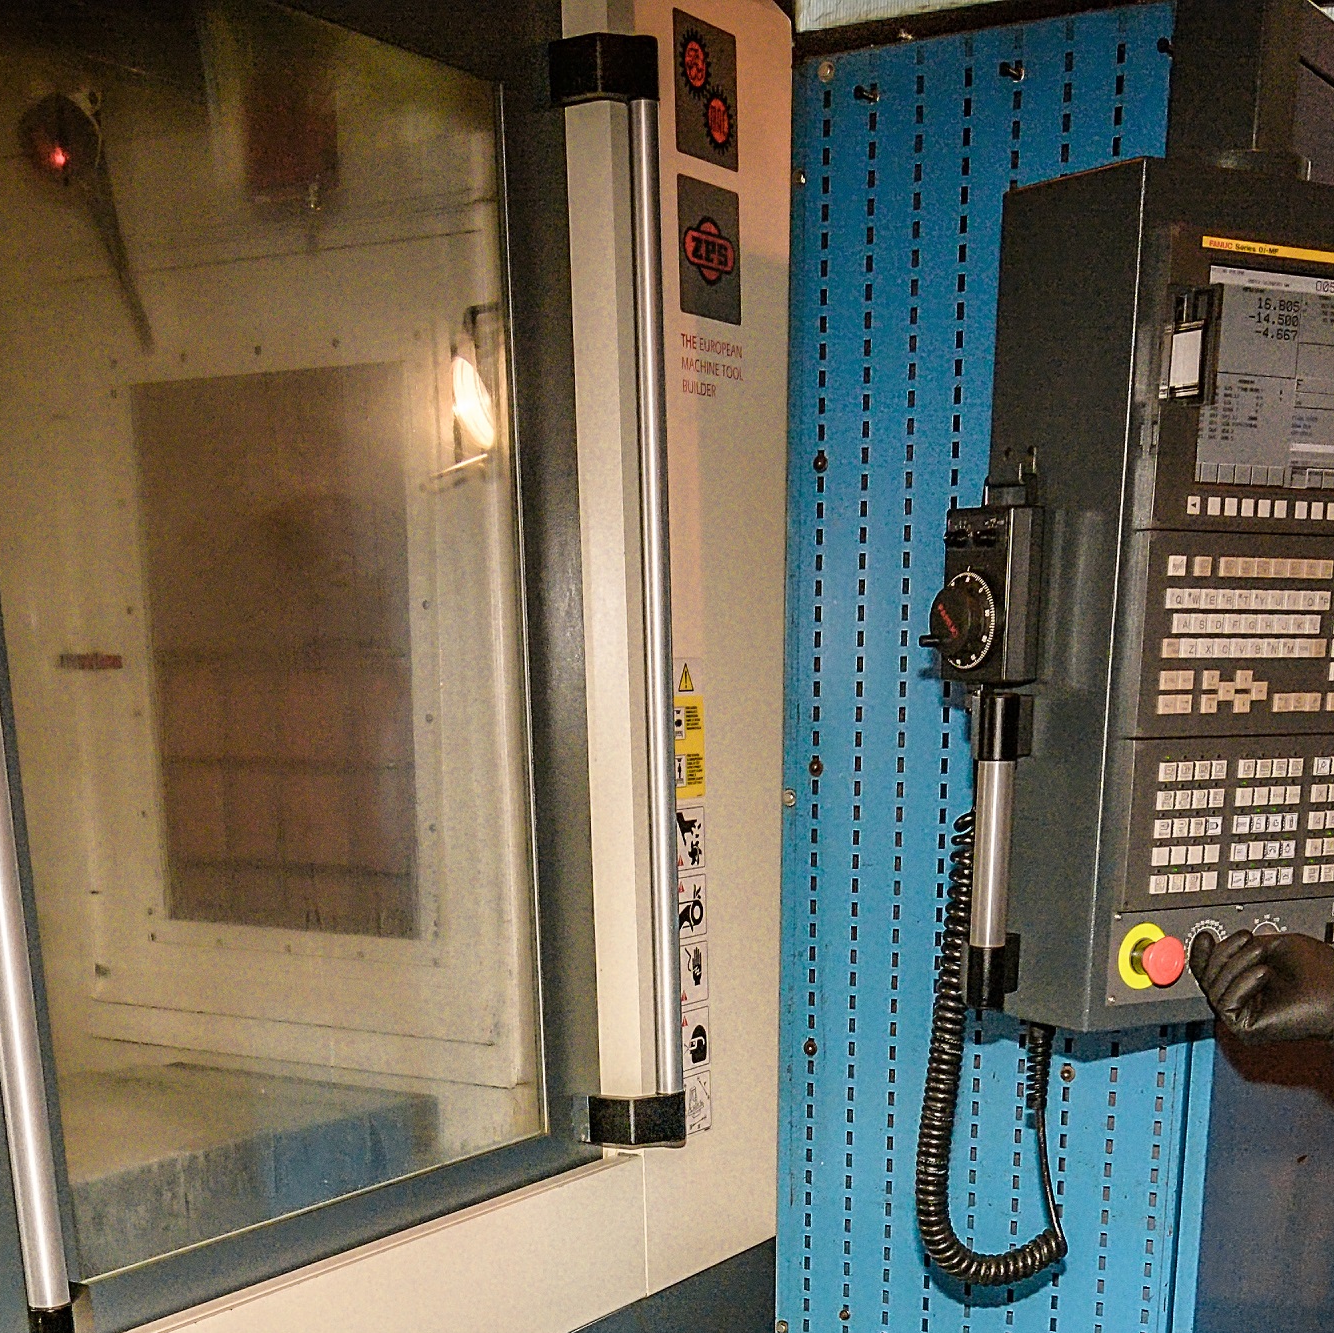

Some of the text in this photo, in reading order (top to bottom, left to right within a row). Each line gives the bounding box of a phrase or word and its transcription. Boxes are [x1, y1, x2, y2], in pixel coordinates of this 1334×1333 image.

[691, 235, 729, 267] ZPS
[1208, 239, 1233, 250] FANUC
[1235, 243, 1256, 253] Series
[1258, 297, 1300, 313] 16.805
[1249, 313, 1299, 326] -14.500
[1255, 327, 1298, 341] -4.667
[681, 333, 743, 359] THE EUROPEAN
[681, 356, 744, 381] MACHINE TOOL
[682, 379, 717, 398] BUILDER
